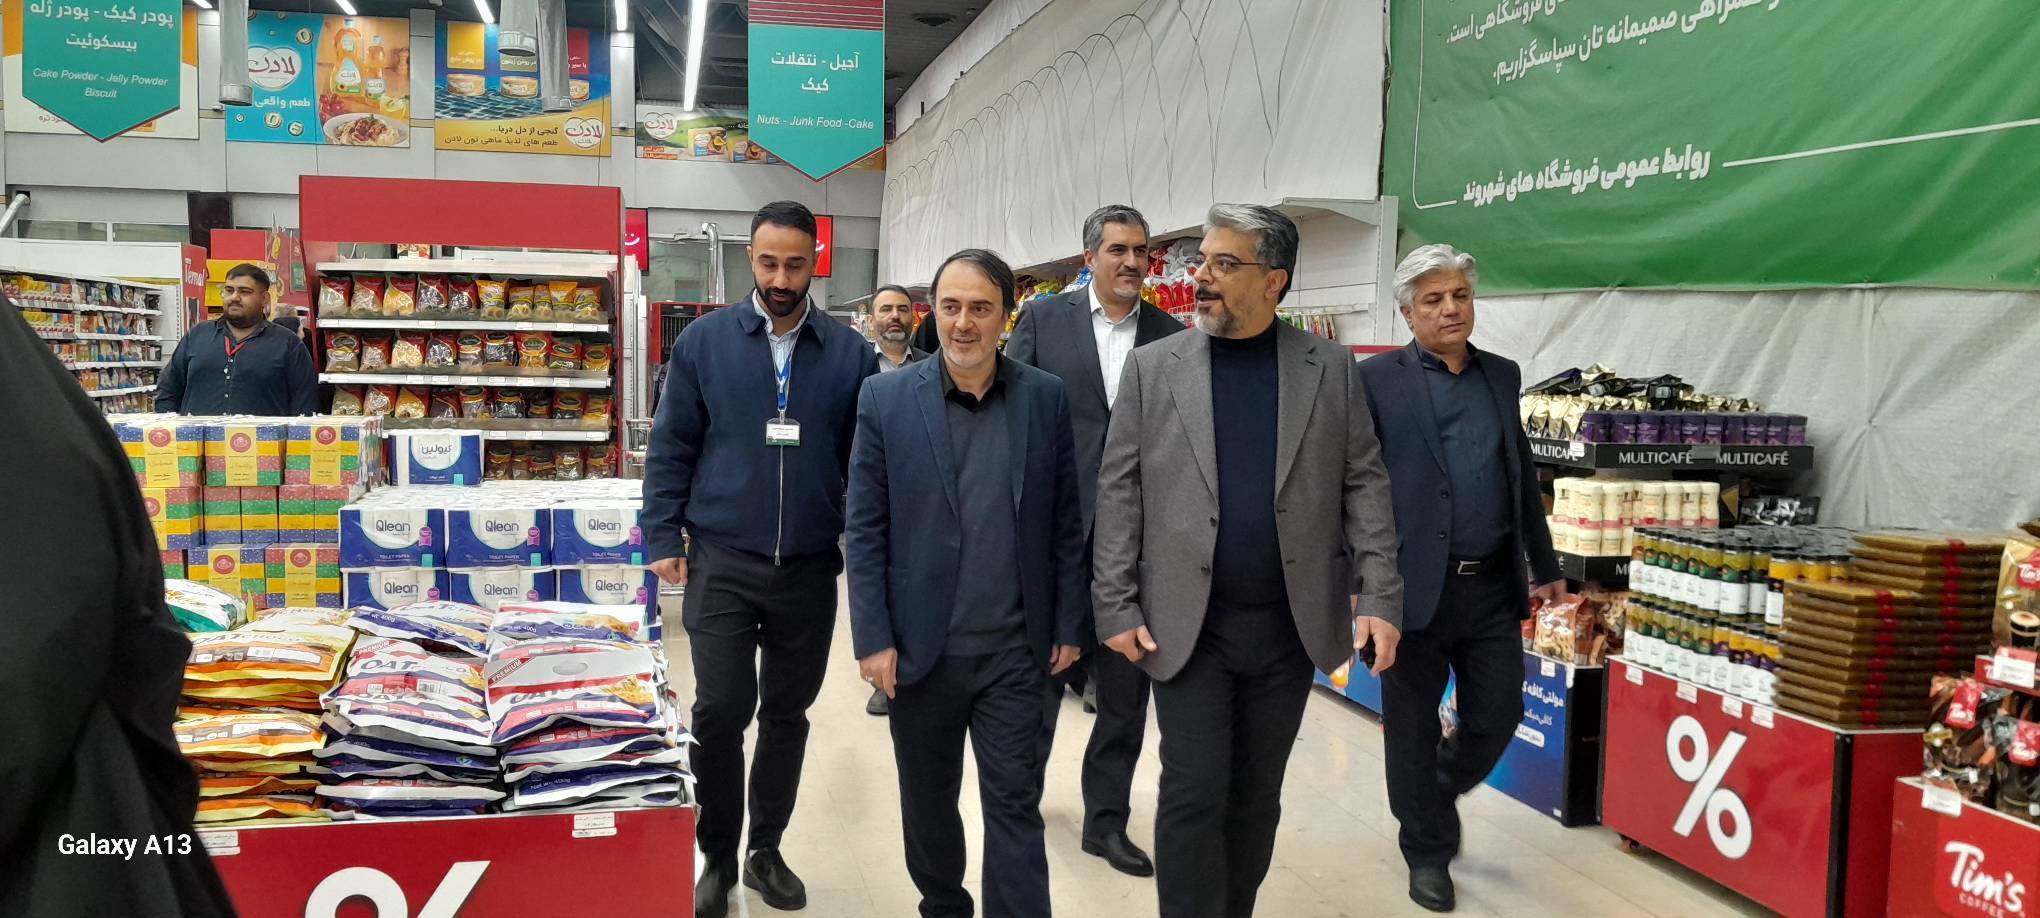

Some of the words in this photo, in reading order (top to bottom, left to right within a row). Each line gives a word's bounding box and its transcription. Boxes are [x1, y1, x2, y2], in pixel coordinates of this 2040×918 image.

[56, 4, 89, 21] پودر
[103, 5, 137, 23] کیک
[141, 11, 175, 29] پودر
[1606, 10, 1678, 45] صمیمانه
[66, 33, 138, 53] بیسکوئیت
[1579, 24, 1604, 61] تان
[829, 51, 860, 71] آجیل
[33, 68, 59, 79] Cake
[61, 70, 99, 81] Powder
[107, 74, 130, 86] Jelly
[131, 75, 169, 86] Powder
[801, 77, 829, 94] کیک
[84, 88, 118, 99] Biscuit
[254, 96, 287, 109] واقعی
[289, 97, 311, 109] طعم
[757, 115, 780, 125] Nuts
[790, 116, 814, 126] Junk
[816, 117, 842, 128] Food
[1661, 144, 1711, 180] روابط
[1535, 157, 1599, 194] فروشگاه
[1600, 156, 1660, 190] عمومی
[1463, 170, 1505, 207] شهروند
[1506, 170, 1534, 201] های
[376, 519, 411, 532] Qlean
[485, 520, 520, 533] Qlean
[588, 518, 622, 532] Qlean
[384, 582, 419, 595] Qlean
[484, 583, 518, 596] Qlean
[595, 579, 629, 592] Qlean
[491, 658, 522, 683] PREMIUM
[1944, 840, 2026, 913] Tim's
